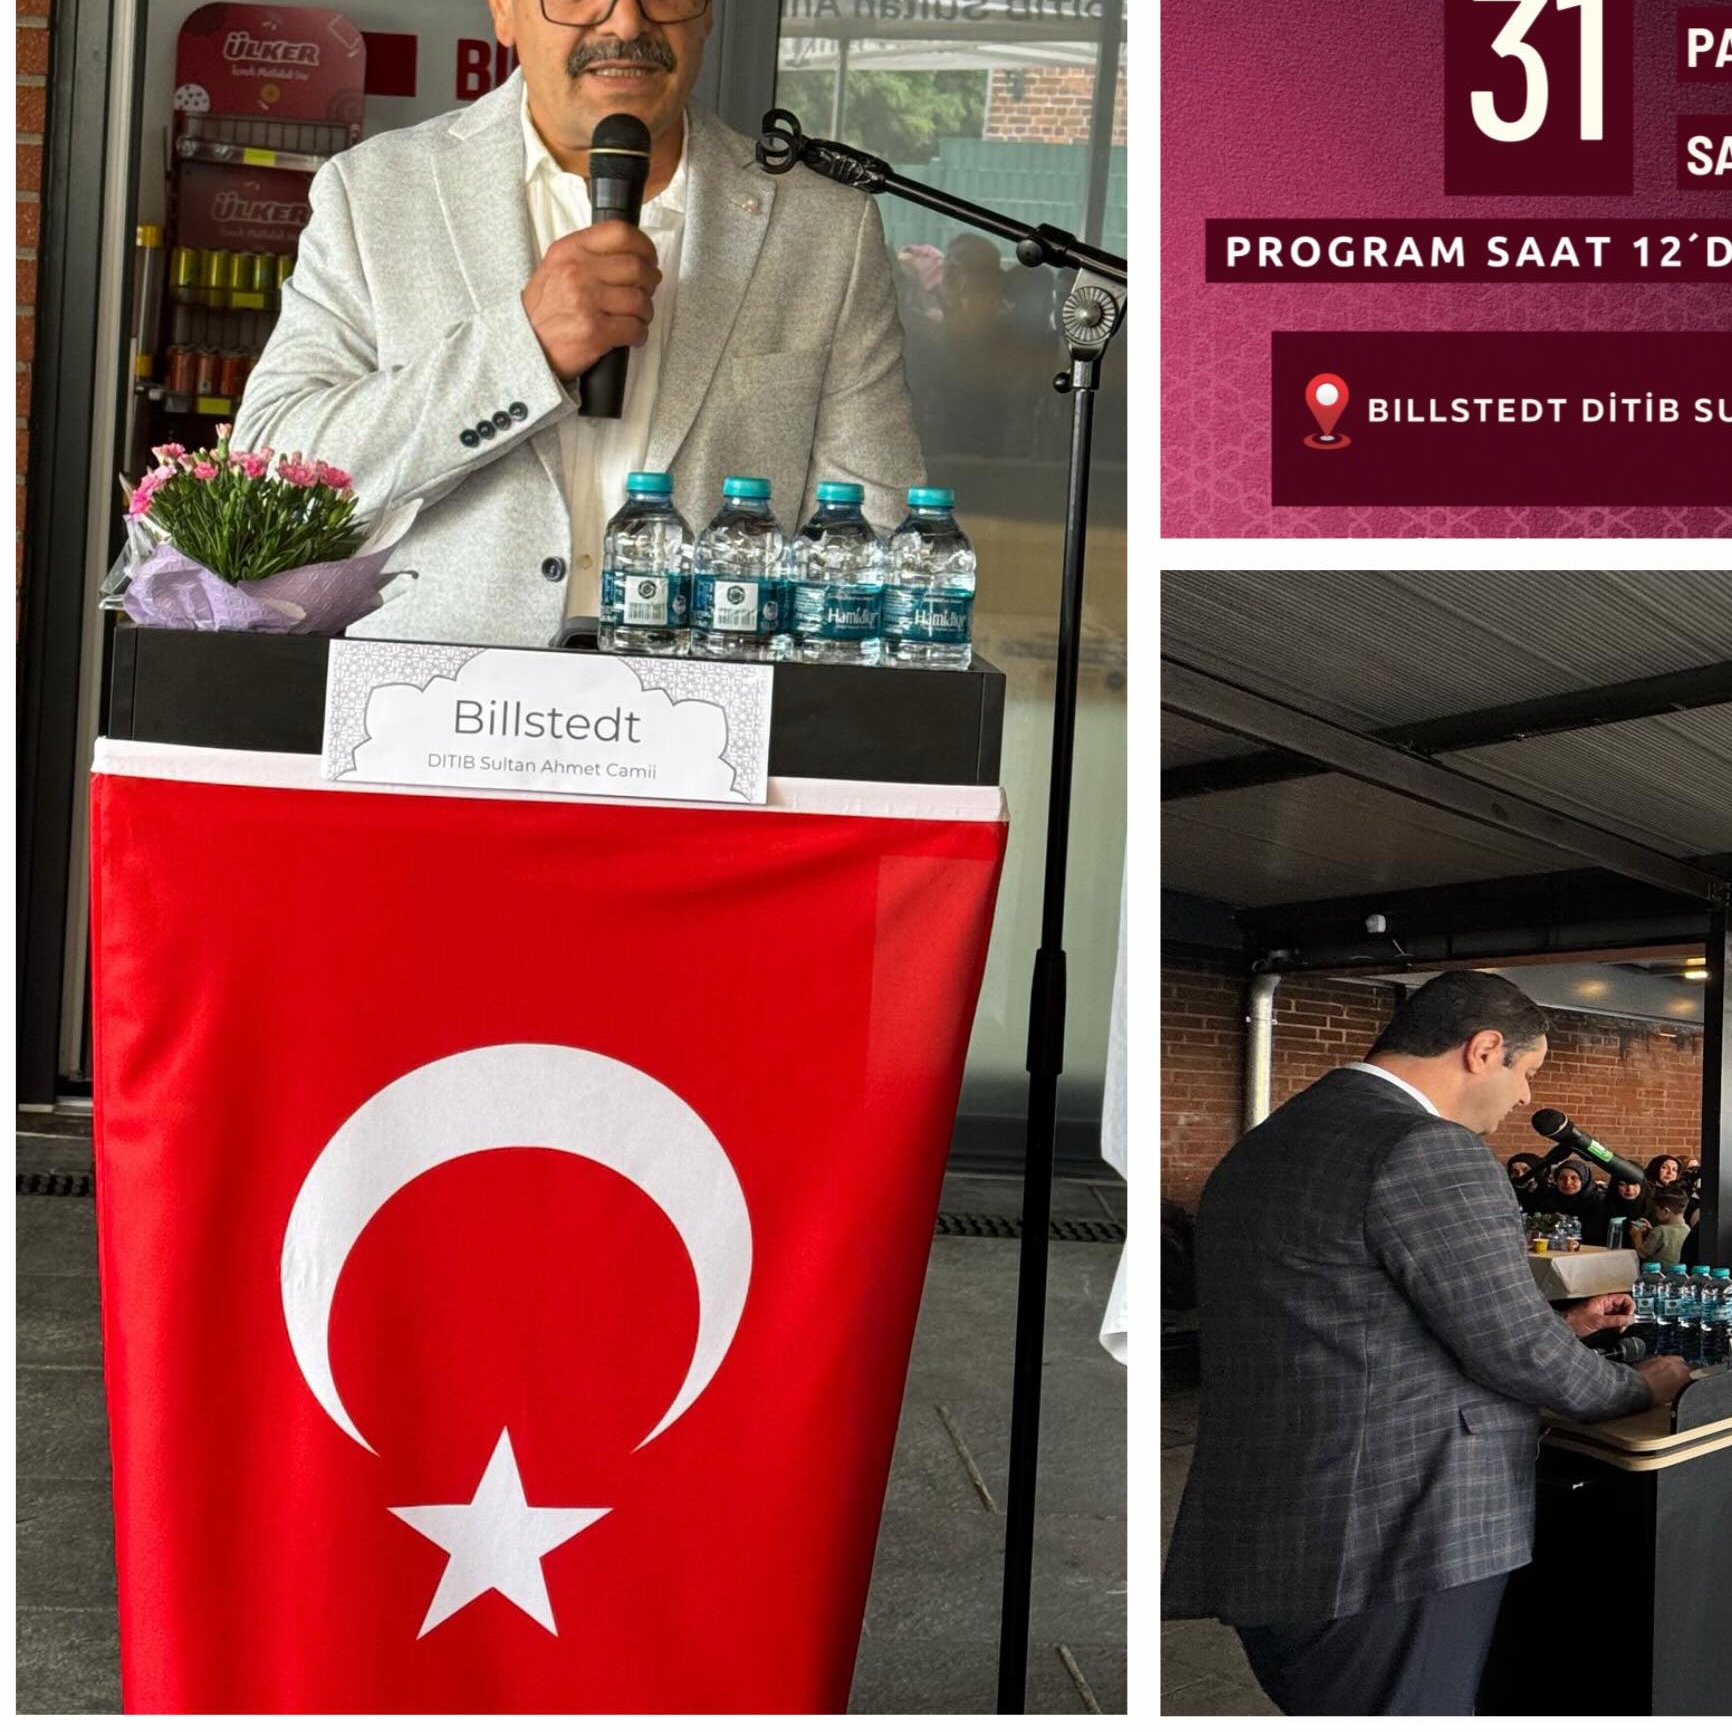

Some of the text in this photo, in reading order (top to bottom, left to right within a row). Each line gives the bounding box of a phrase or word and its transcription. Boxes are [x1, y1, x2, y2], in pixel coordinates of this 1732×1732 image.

[223, 31, 320, 66] ÜLKER
[1227, 236, 1465, 268] PROGRAM
[1487, 236, 1611, 268] SAAT
[1369, 398, 1567, 423] BILLSTEDT
[1582, 392, 1679, 422] DİTİB
[454, 699, 641, 744] Billstedt
[428, 752, 657, 780] DITIB Sultan Ahmet Camii
